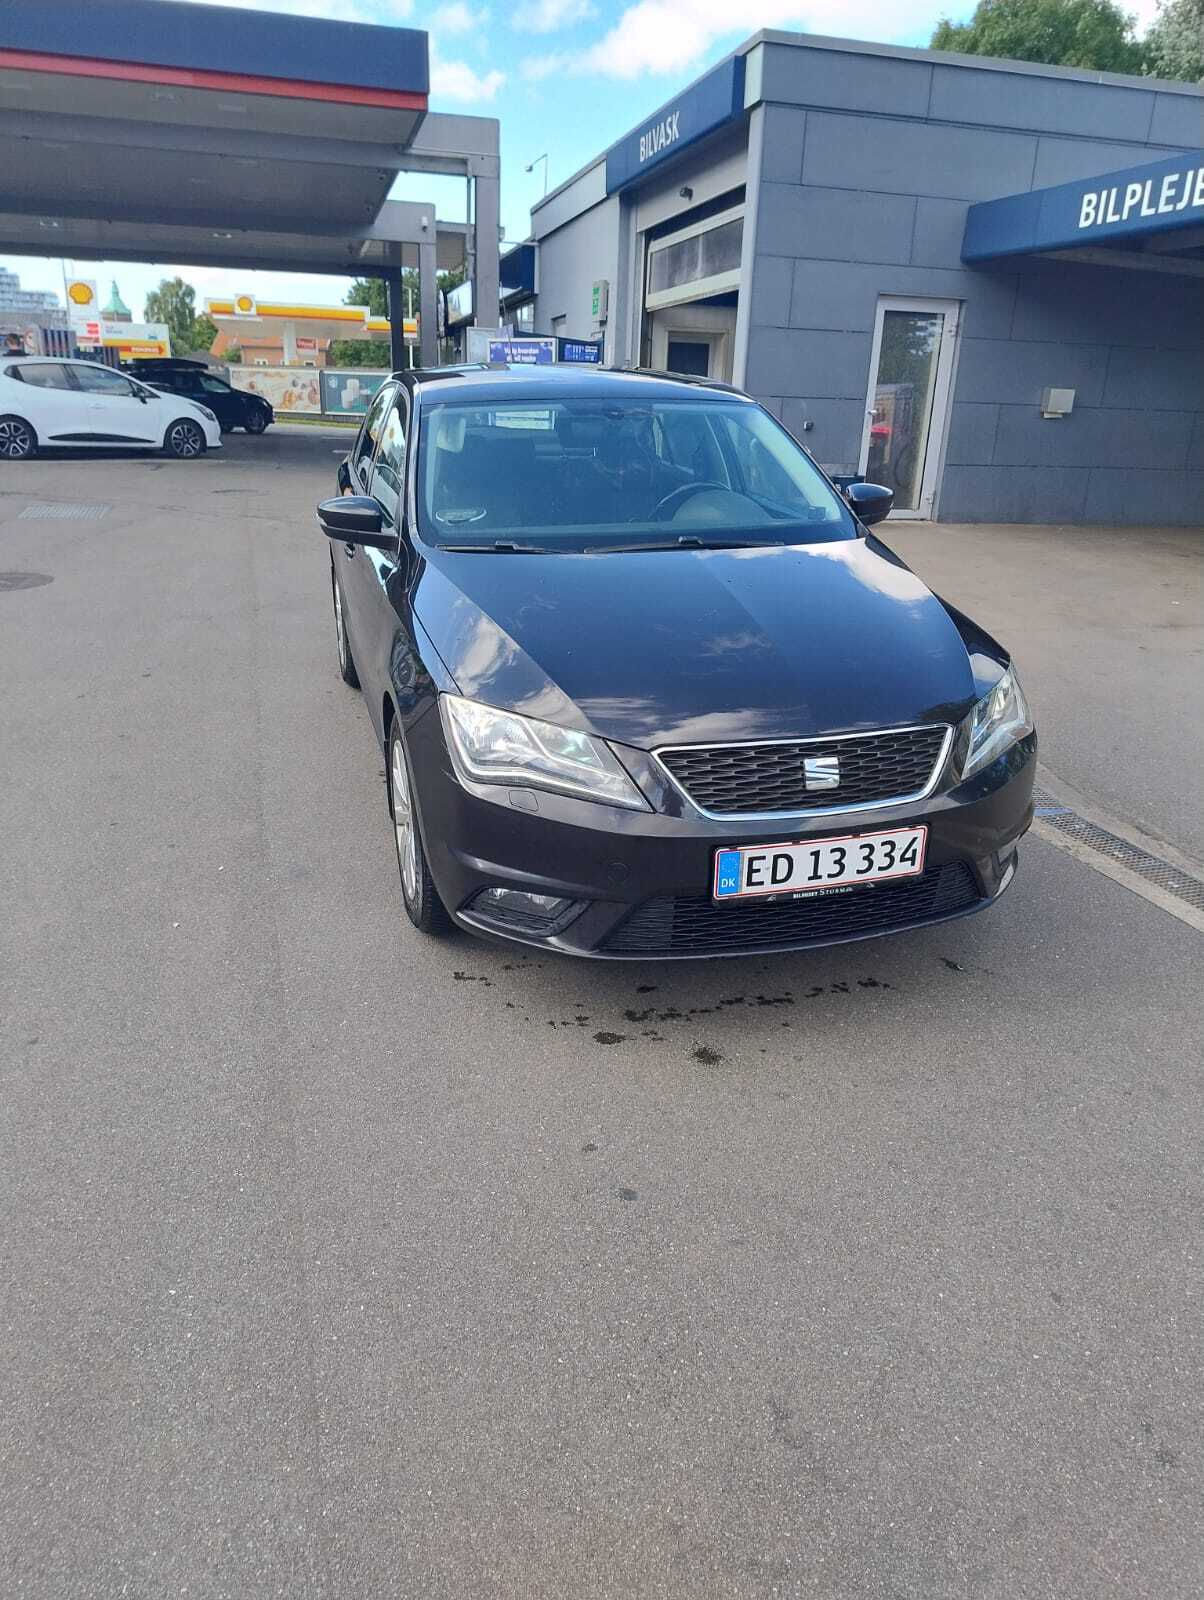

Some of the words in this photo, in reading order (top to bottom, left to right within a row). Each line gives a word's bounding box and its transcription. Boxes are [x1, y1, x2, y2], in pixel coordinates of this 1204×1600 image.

[640, 110, 680, 162] BILVASK
[721, 878, 736, 888] DK
[746, 853, 795, 887] ED
[807, 847, 847, 881] 13
[856, 836, 919, 875] 334
